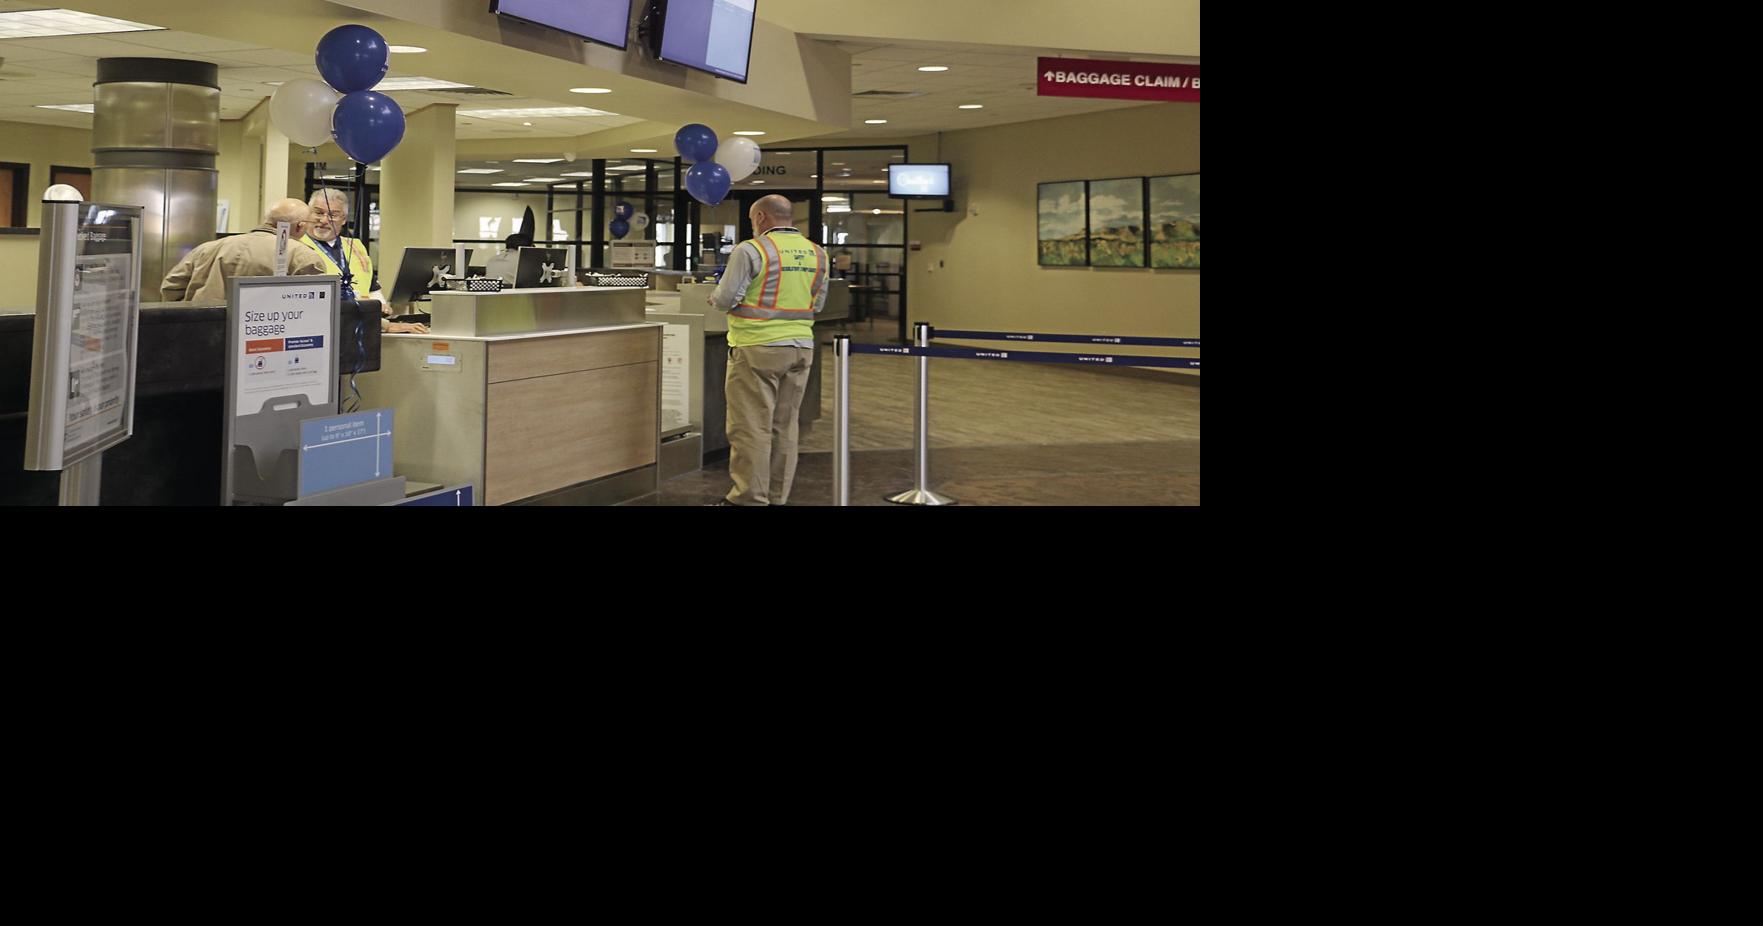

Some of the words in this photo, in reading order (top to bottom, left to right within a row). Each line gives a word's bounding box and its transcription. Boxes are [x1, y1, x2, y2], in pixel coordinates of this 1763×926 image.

[1055, 71, 1131, 86] BAGGAGE
[1134, 75, 1180, 88] CLAIM
[1182, 77, 1189, 89] /
[244, 310, 265, 323] Size
[267, 311, 280, 322] up
[281, 310, 304, 323] your
[244, 324, 286, 337] baggage
